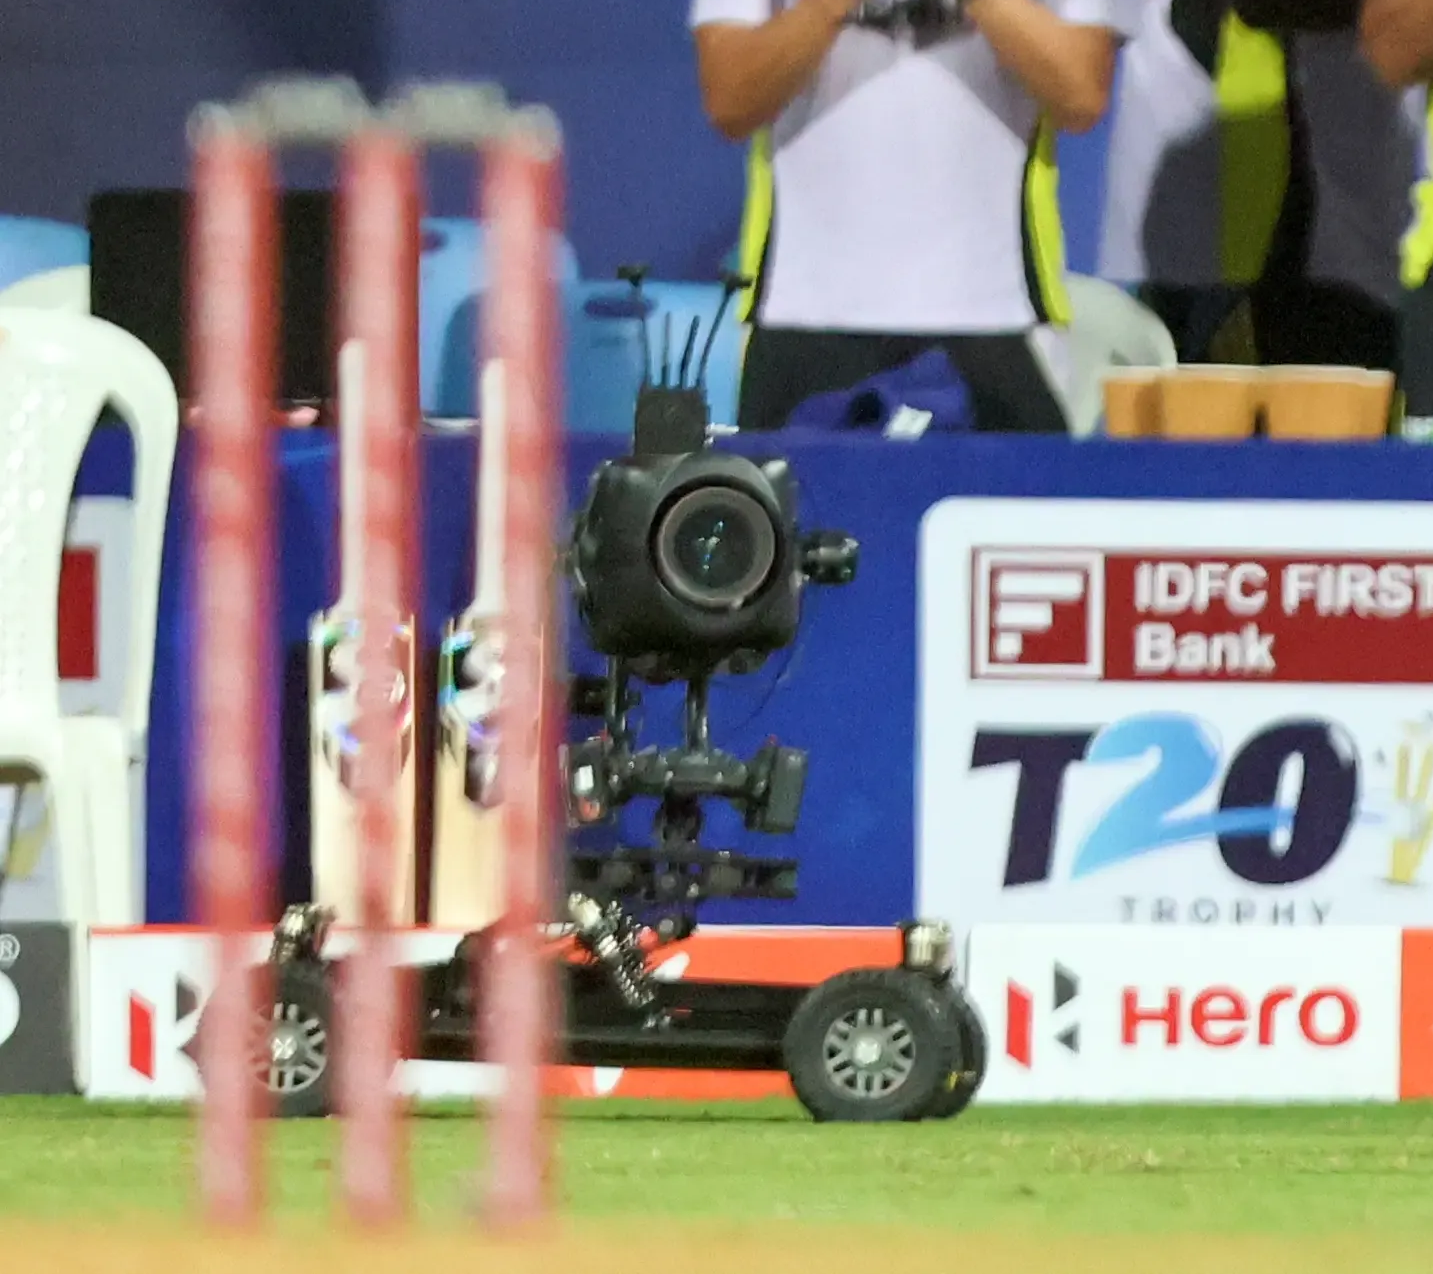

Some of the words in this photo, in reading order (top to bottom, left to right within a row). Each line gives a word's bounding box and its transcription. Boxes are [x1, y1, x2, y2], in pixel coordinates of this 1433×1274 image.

[1134, 562, 1268, 614] IDFC
[1134, 622, 1276, 674] Bank
[968, 710, 1360, 888] T20
[1118, 896, 1334, 925] TROPHY
[1120, 985, 1358, 1047] Hero
